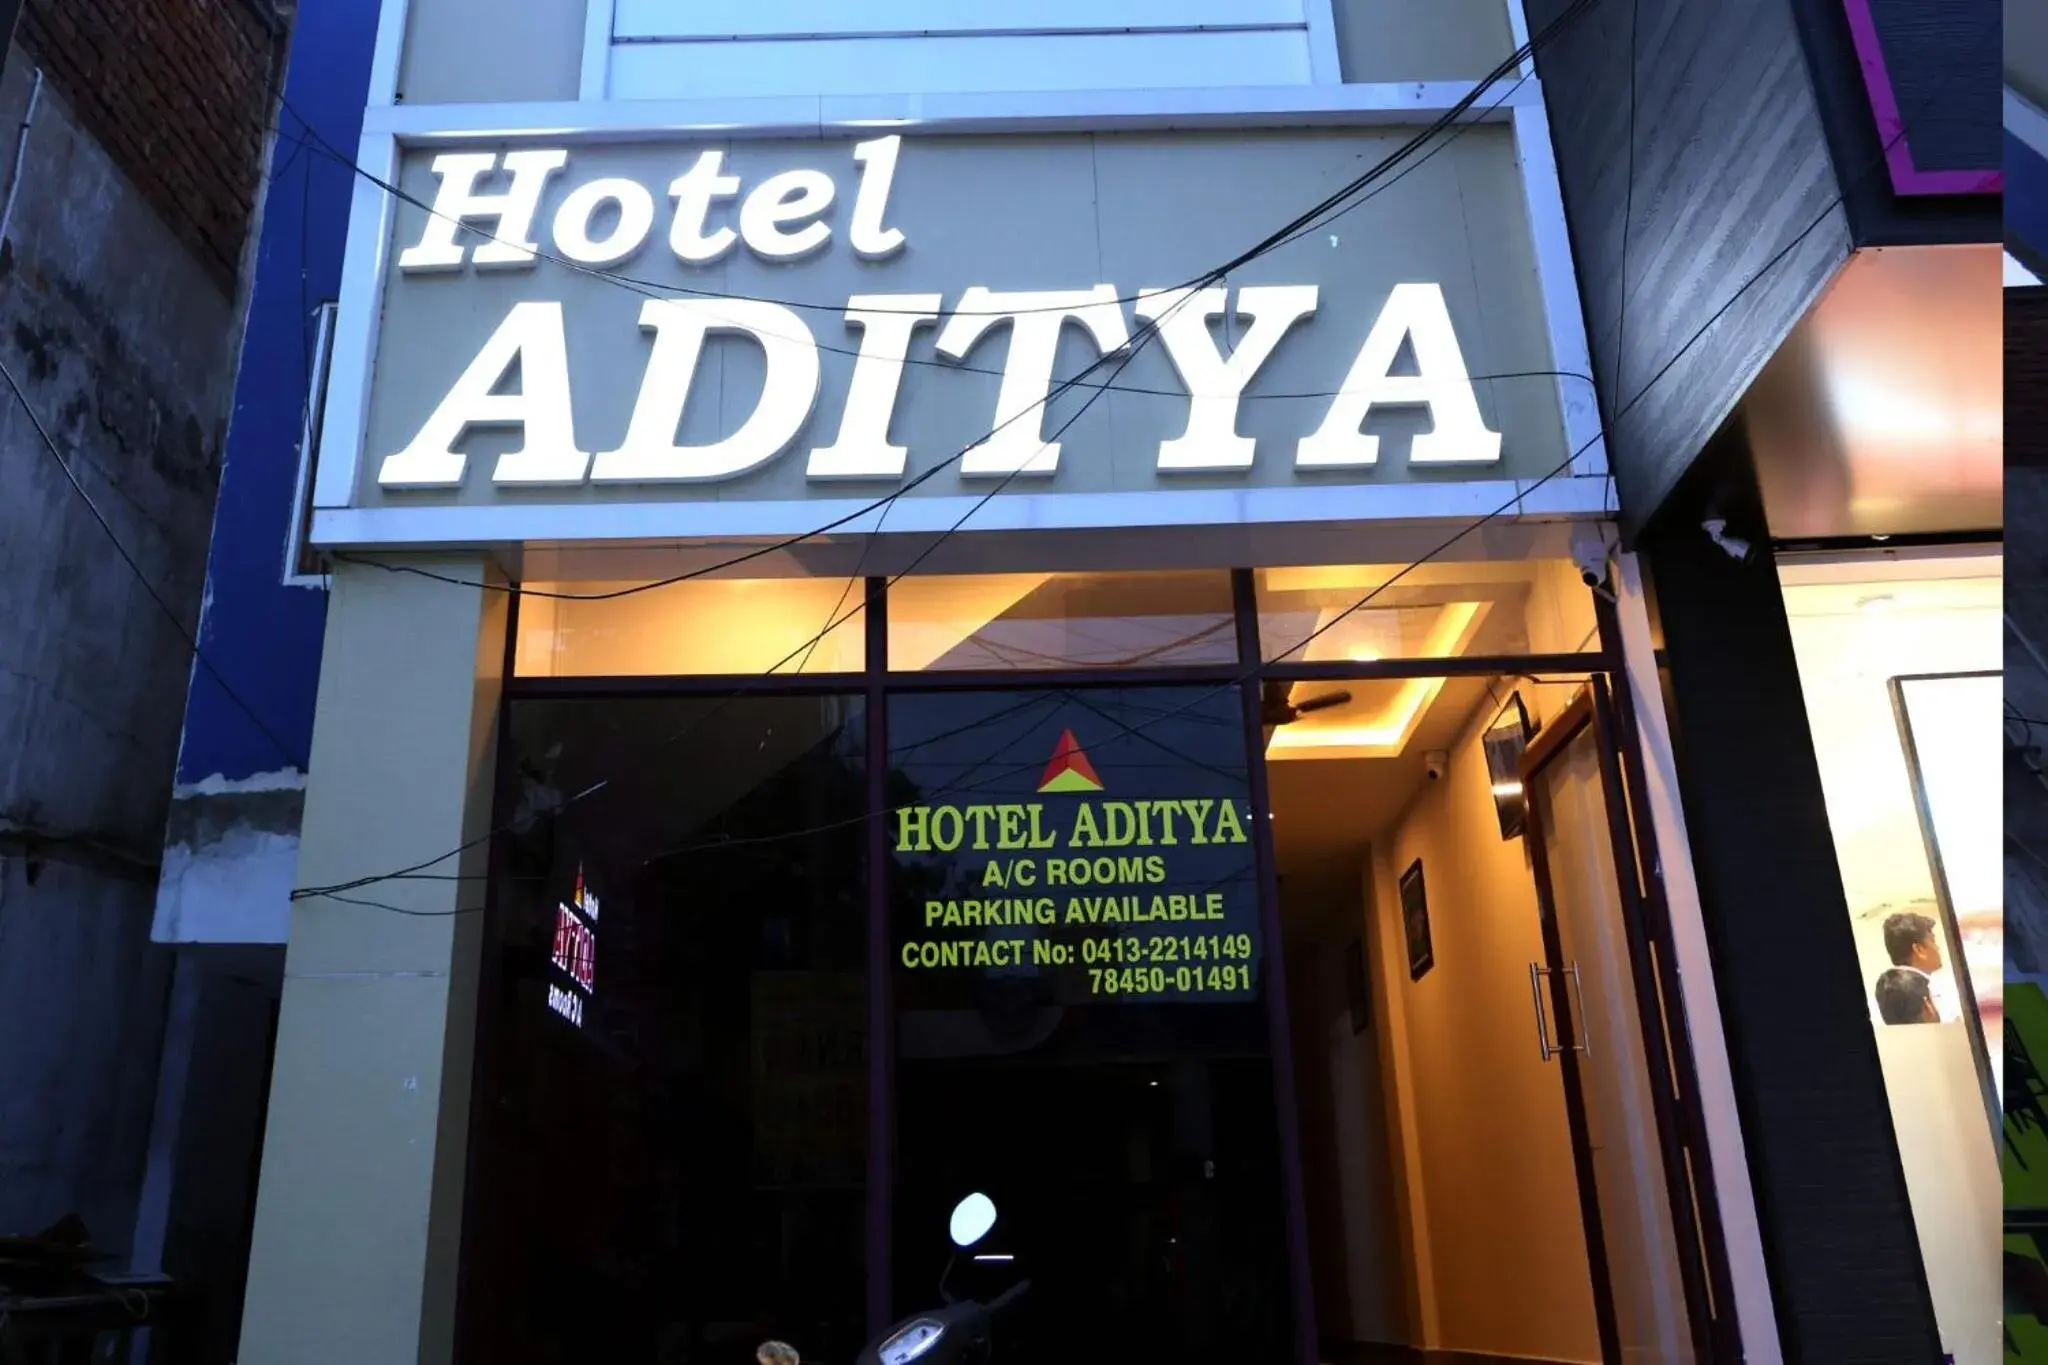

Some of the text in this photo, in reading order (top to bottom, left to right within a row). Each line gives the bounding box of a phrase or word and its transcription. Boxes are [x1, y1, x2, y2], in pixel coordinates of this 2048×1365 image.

[398, 134, 906, 270] Hotel
[377, 281, 1503, 486] ADITYA
[895, 799, 1247, 852] HOTEL ADITYA
[982, 855, 1166, 889] A/C ROOMS
[924, 893, 1224, 927] PARKING AVAILABLE
[901, 934, 1252, 968] CONTACT No: 0413-2214149
[1089, 965, 1251, 994] 78450-01491
